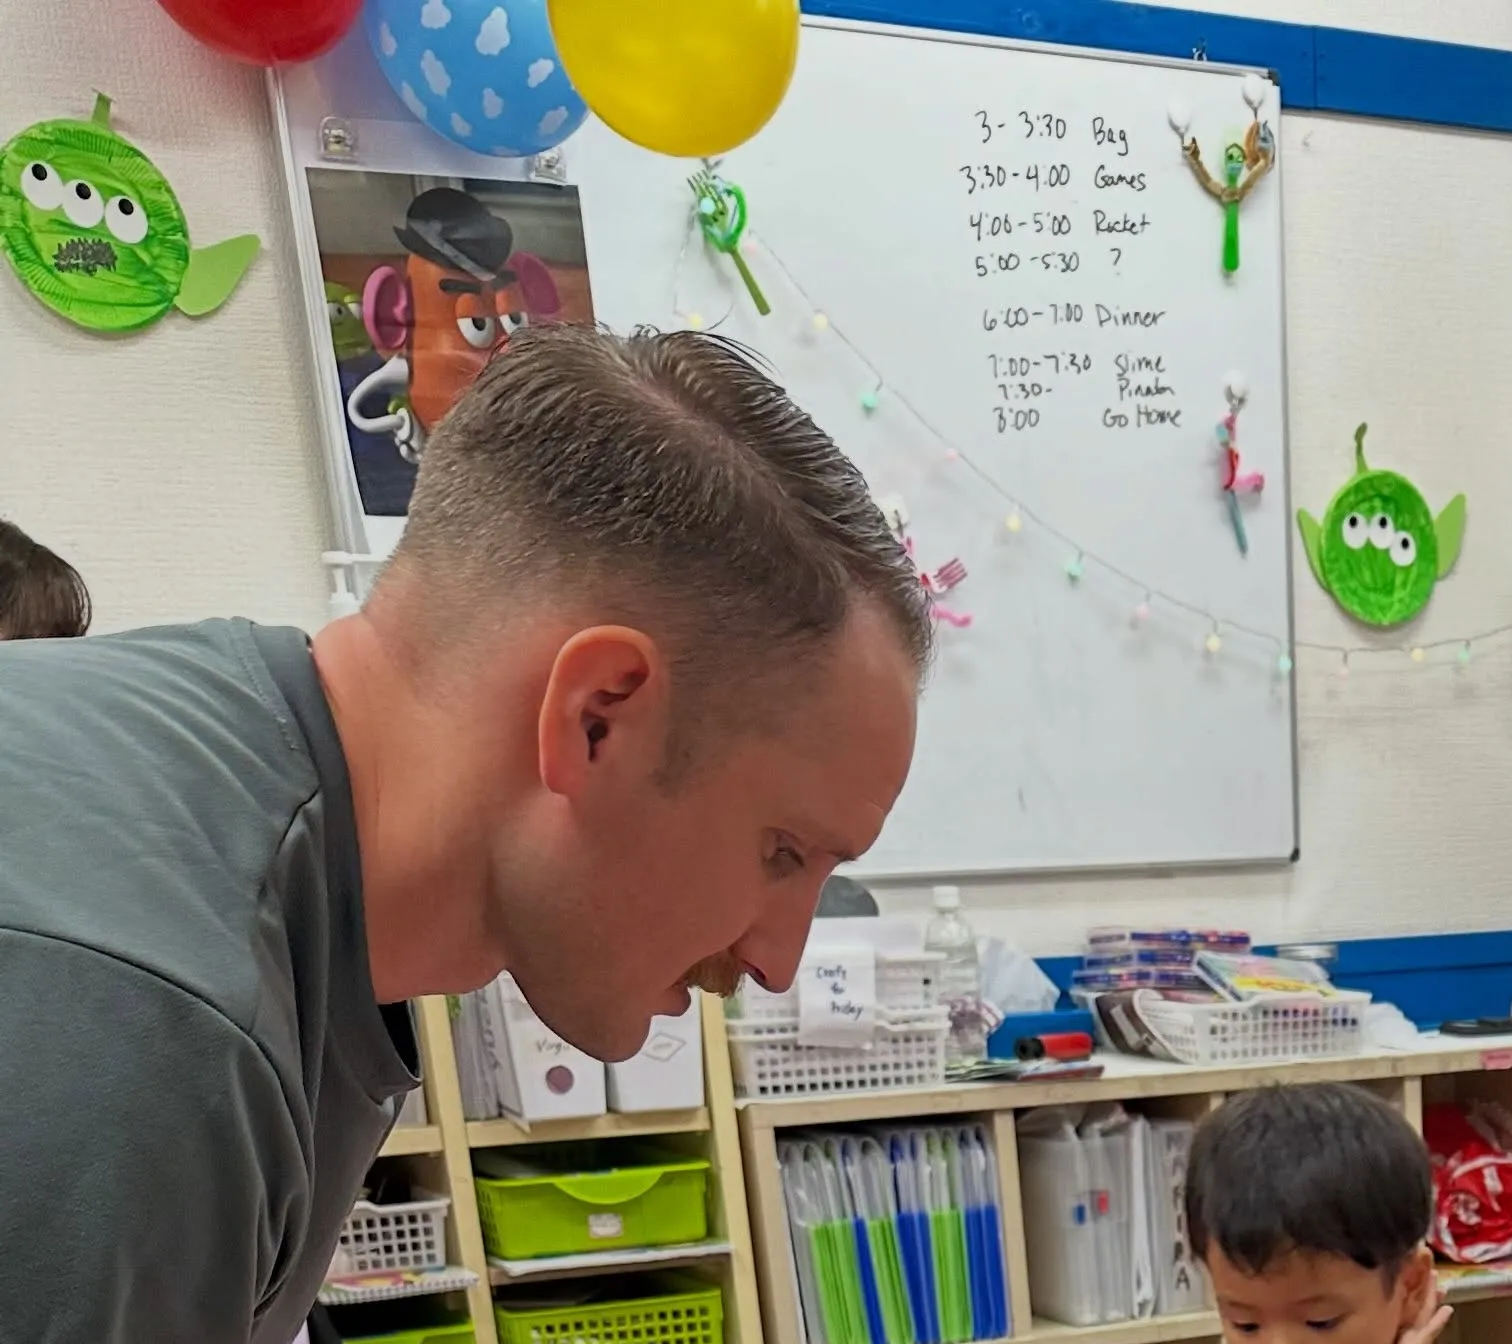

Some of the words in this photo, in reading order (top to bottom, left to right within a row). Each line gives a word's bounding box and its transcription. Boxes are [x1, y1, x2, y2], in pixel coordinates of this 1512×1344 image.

[1092, 116, 1129, 157] Bag
[1094, 164, 1147, 192] Games
[1095, 303, 1166, 328] Dinner
[1114, 351, 1167, 378] Slime
[1136, 403, 1182, 429] Home
